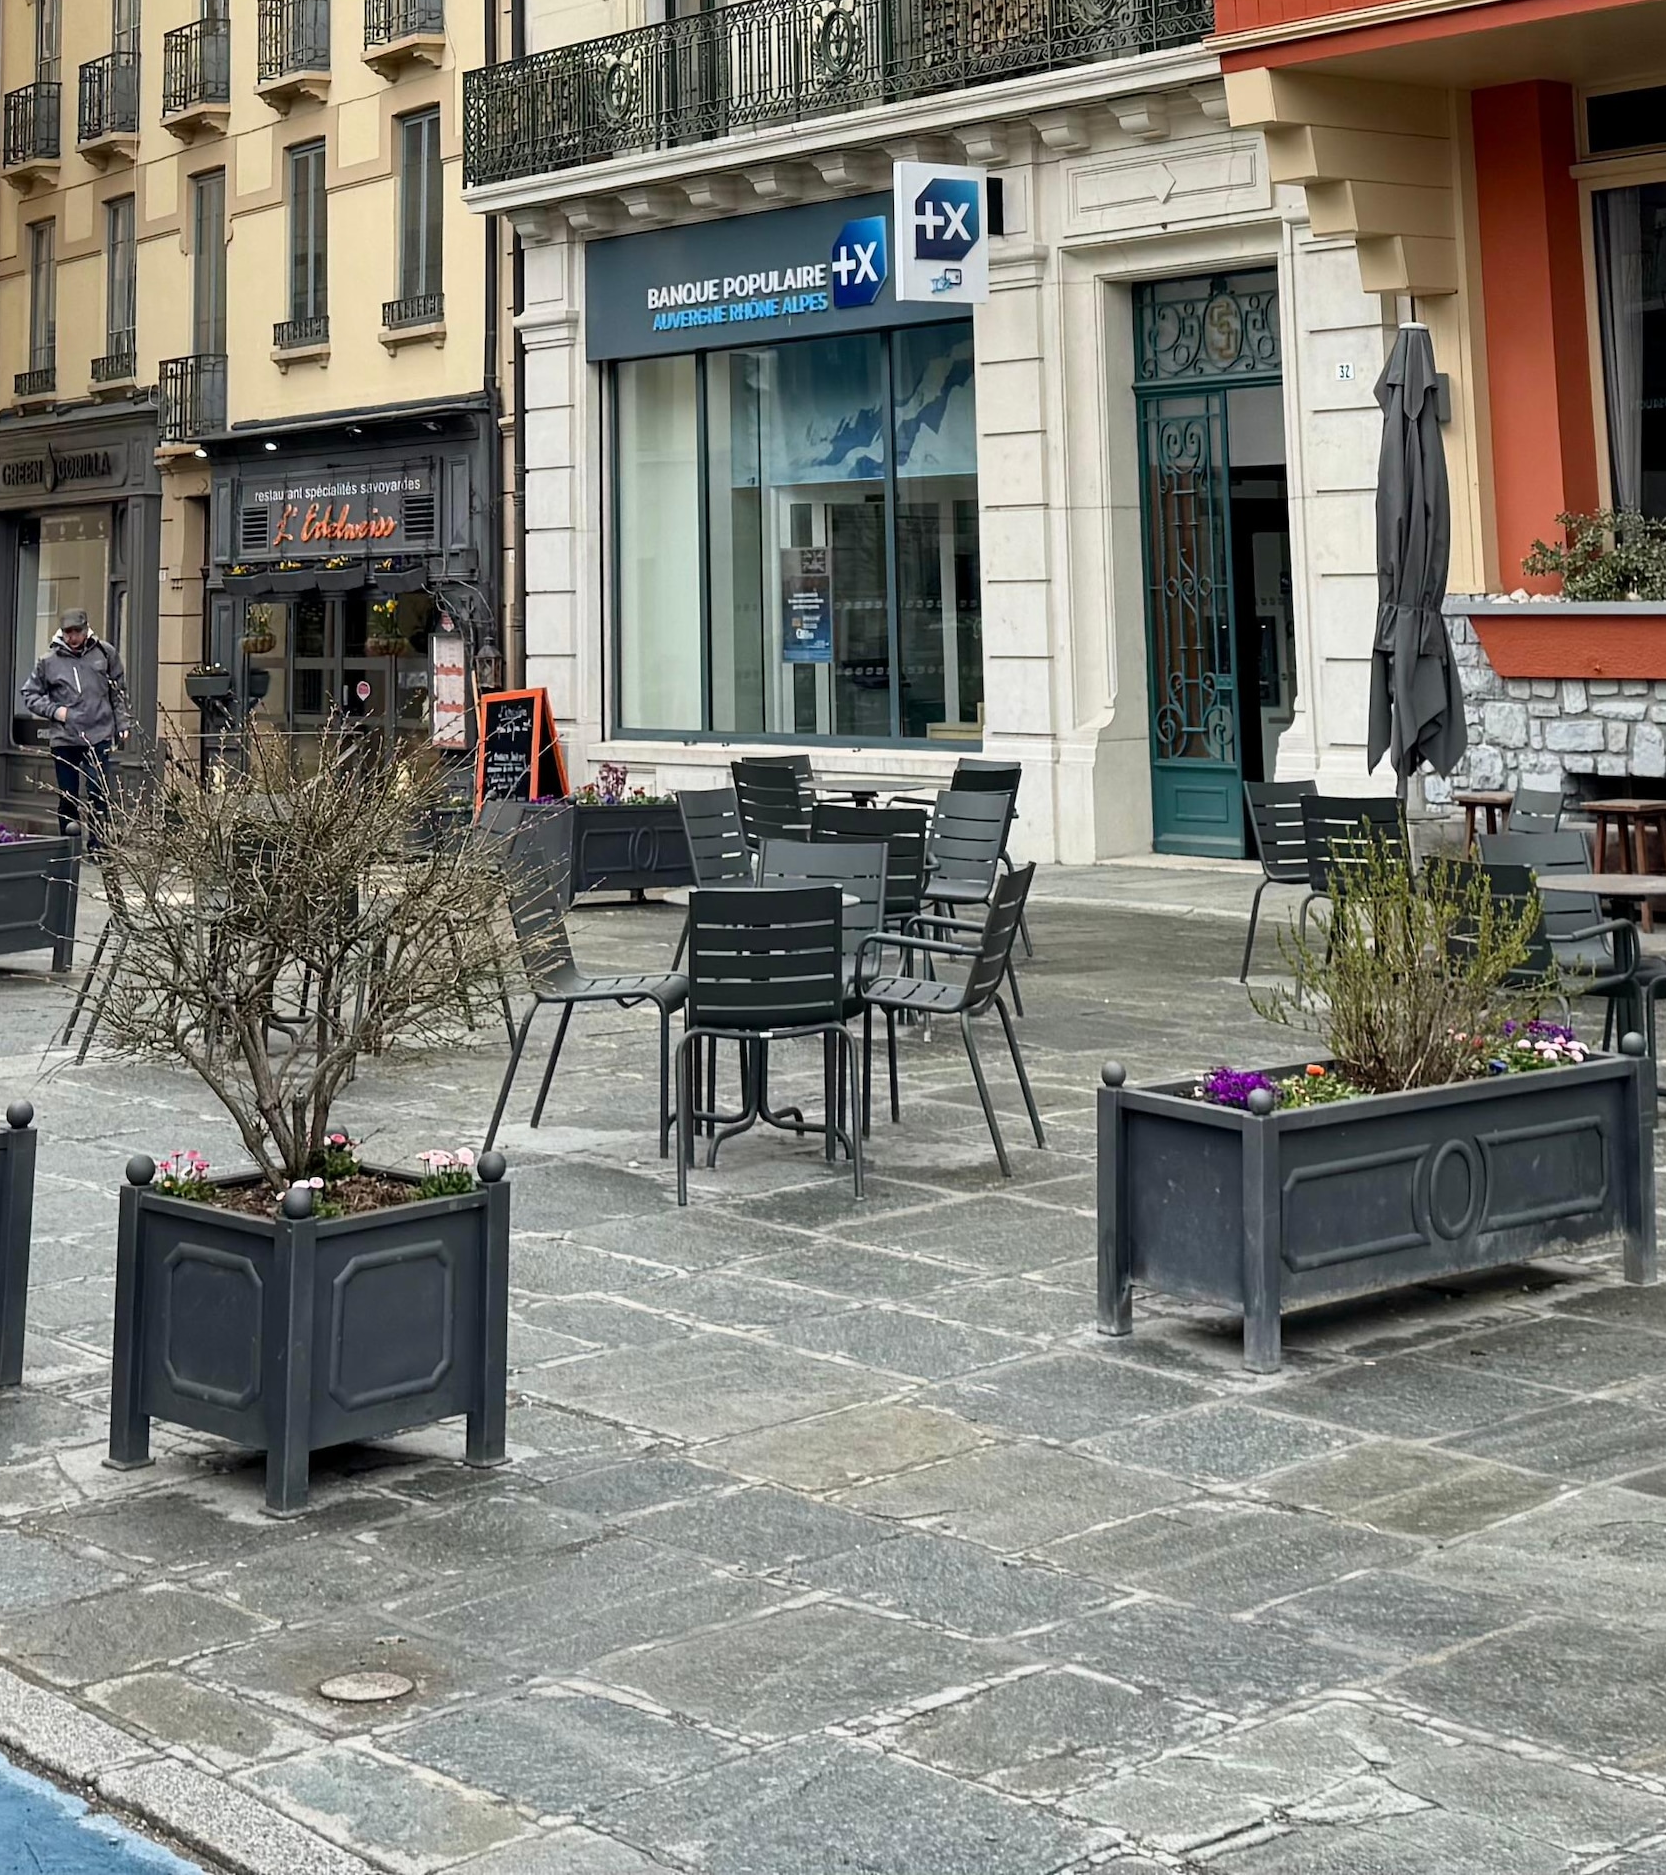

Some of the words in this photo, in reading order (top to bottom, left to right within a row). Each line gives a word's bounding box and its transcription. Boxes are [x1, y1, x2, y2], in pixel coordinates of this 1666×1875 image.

[647, 278, 720, 311] BANQUE
[723, 263, 828, 300] POPULAIRE
[652, 304, 727, 332] AUVERGNE
[729, 296, 780, 322] RHÔNE
[782, 291, 829, 316] ALPES
[1338, 364, 1350, 378] 32
[2, 460, 43, 486] GREEN
[56, 451, 112, 480] GORILLA
[254, 486, 303, 503] restaurant
[305, 481, 358, 500] spécialités
[360, 476, 421, 495] savoyardes
